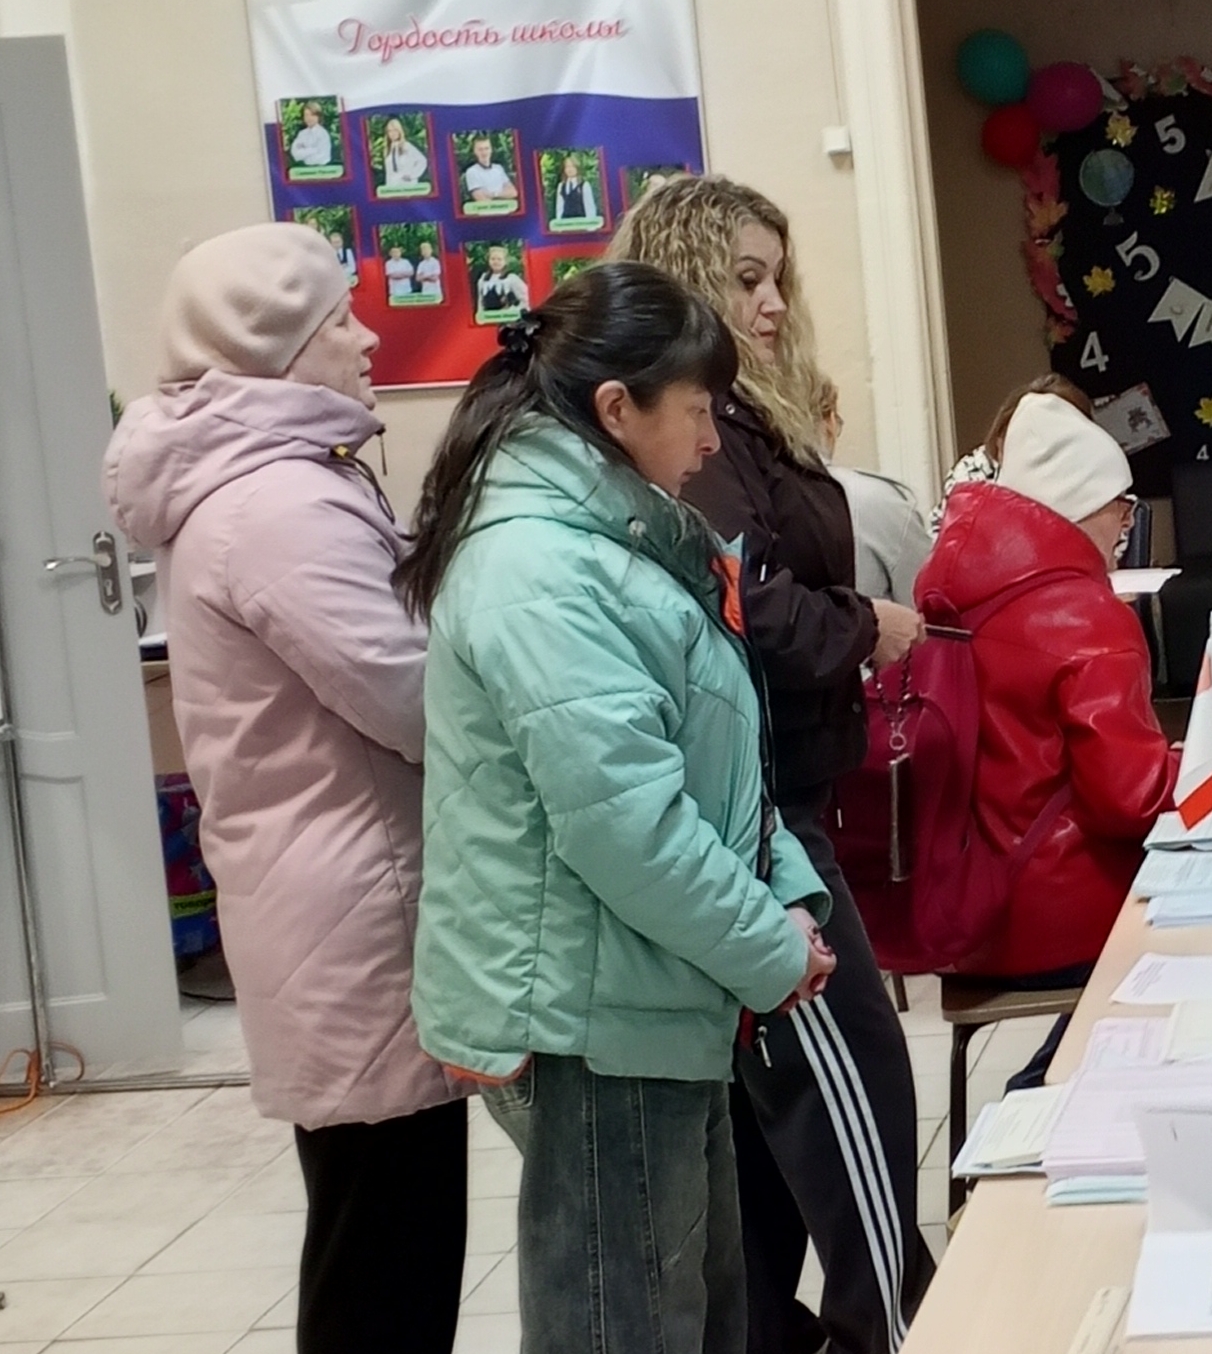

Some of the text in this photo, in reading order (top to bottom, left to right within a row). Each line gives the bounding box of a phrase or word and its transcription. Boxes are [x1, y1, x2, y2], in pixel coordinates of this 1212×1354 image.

[337, 13, 629, 65] Гордость школы
[1154, 114, 1187, 154] 5
[1115, 231, 1161, 281] 5
[1080, 331, 1110, 373] 4
[1195, 444, 1210, 461] 4
